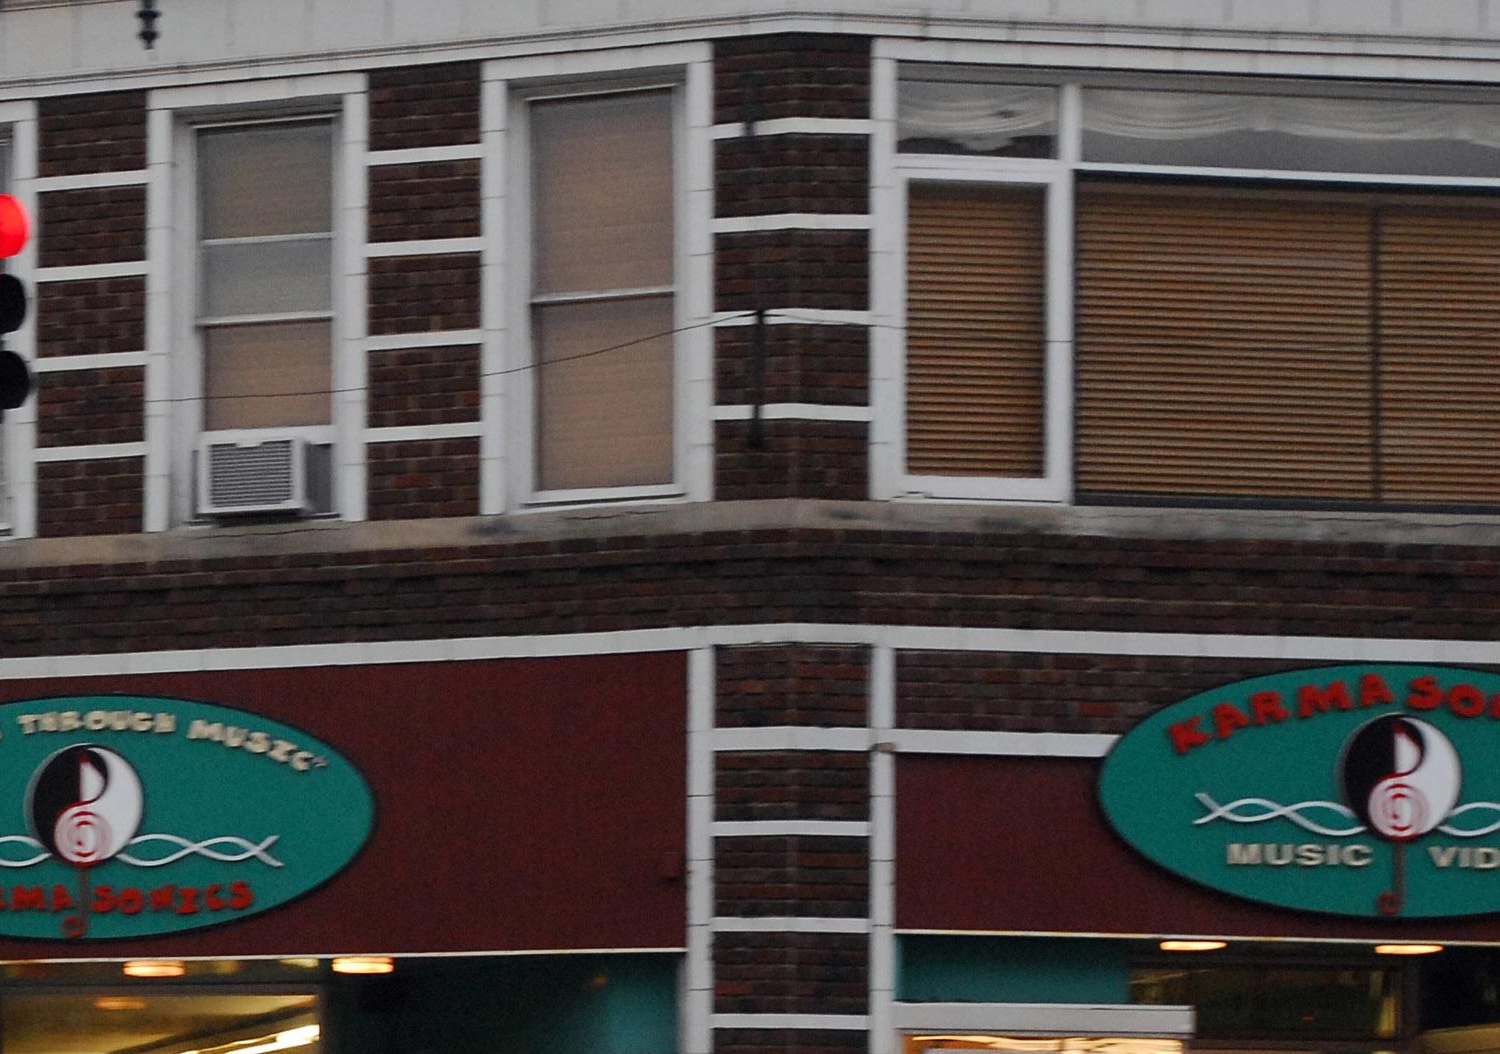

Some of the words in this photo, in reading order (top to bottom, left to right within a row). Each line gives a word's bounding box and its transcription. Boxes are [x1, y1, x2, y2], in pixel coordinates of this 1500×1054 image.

[1166, 673, 1394, 755] KARMA
[1406, 676, 1500, 719] SO
[1227, 843, 1372, 868] MUSIC
[92, 880, 255, 915] SONICS
